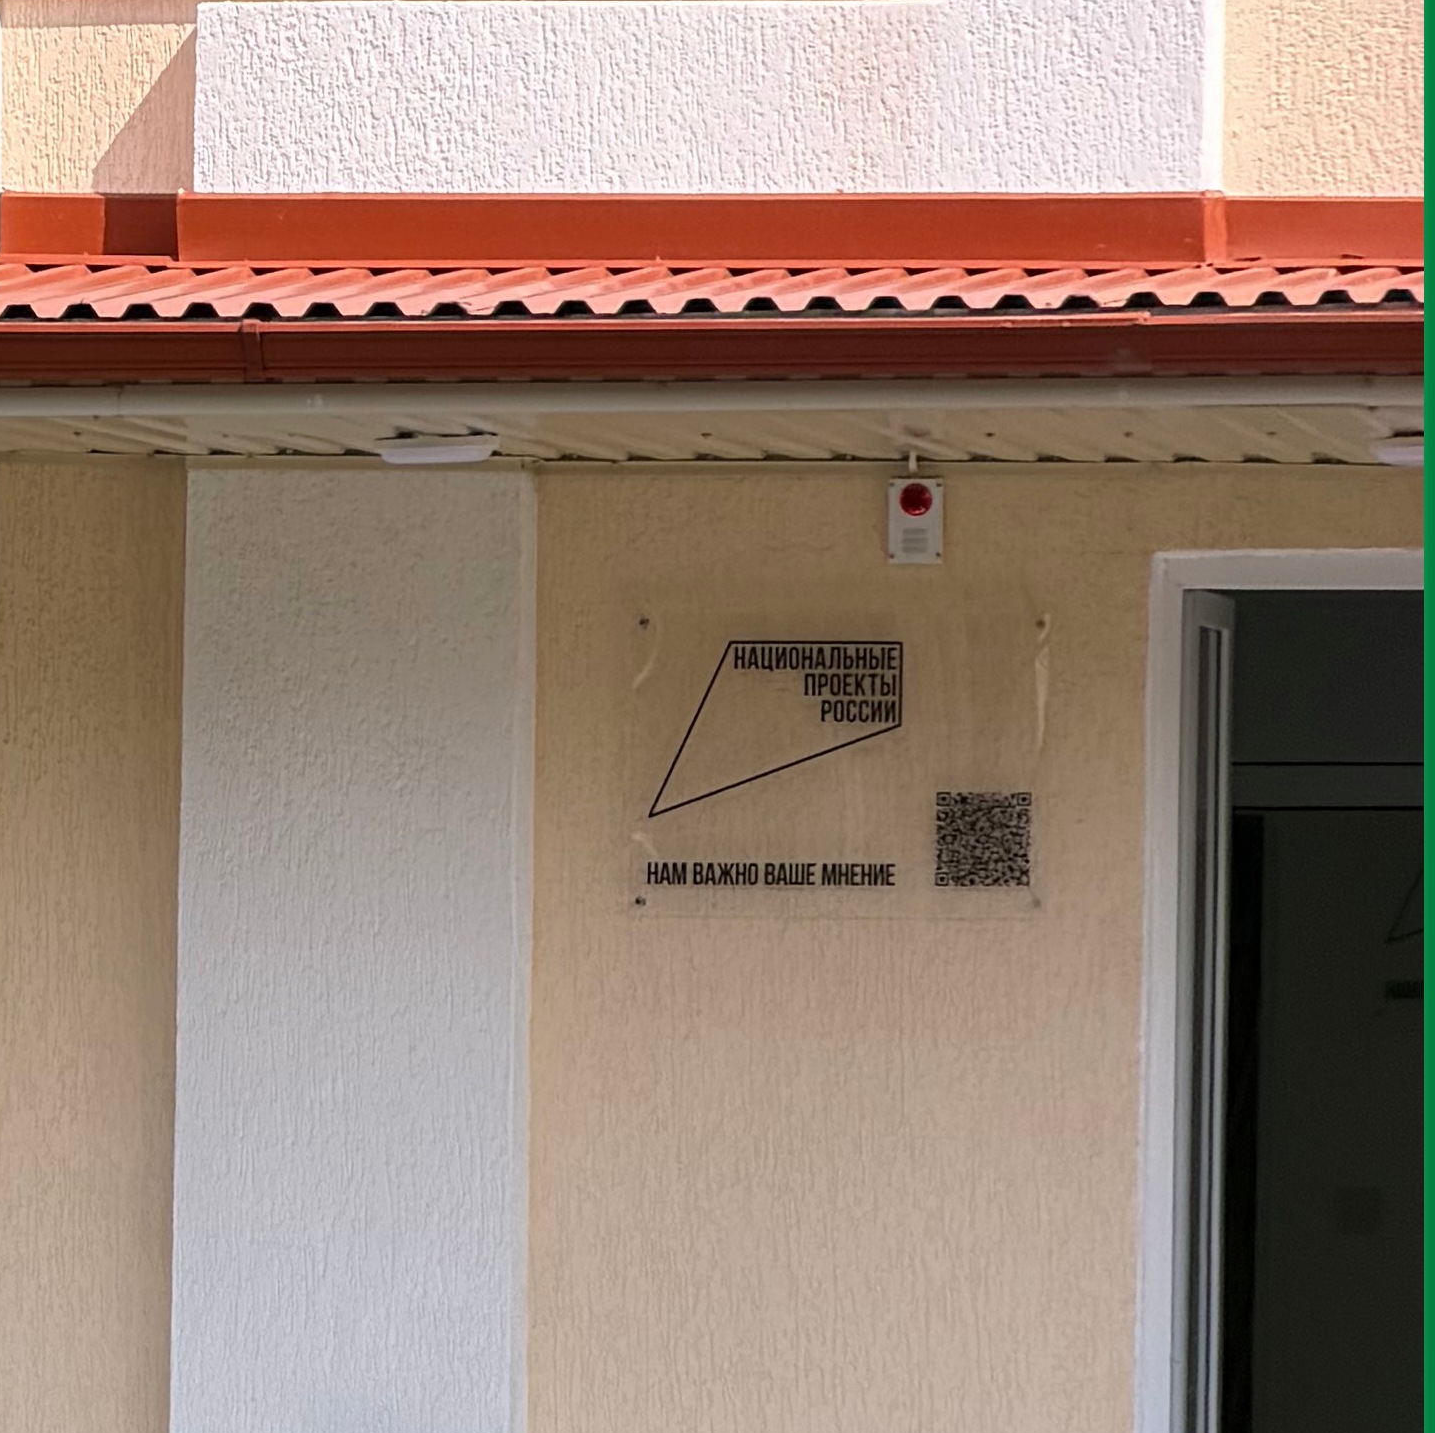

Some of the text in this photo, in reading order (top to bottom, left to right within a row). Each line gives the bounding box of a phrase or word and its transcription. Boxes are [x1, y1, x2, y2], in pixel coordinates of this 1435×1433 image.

[733, 647, 897, 670] НАЦИОНАЛЬНЫЕ
[804, 674, 896, 696] ПРОЕКТЫ
[821, 700, 896, 722] РОССИИ
[648, 862, 895, 887] НАМ ВАЖНО ВАШЕ МНЕНИЕ
